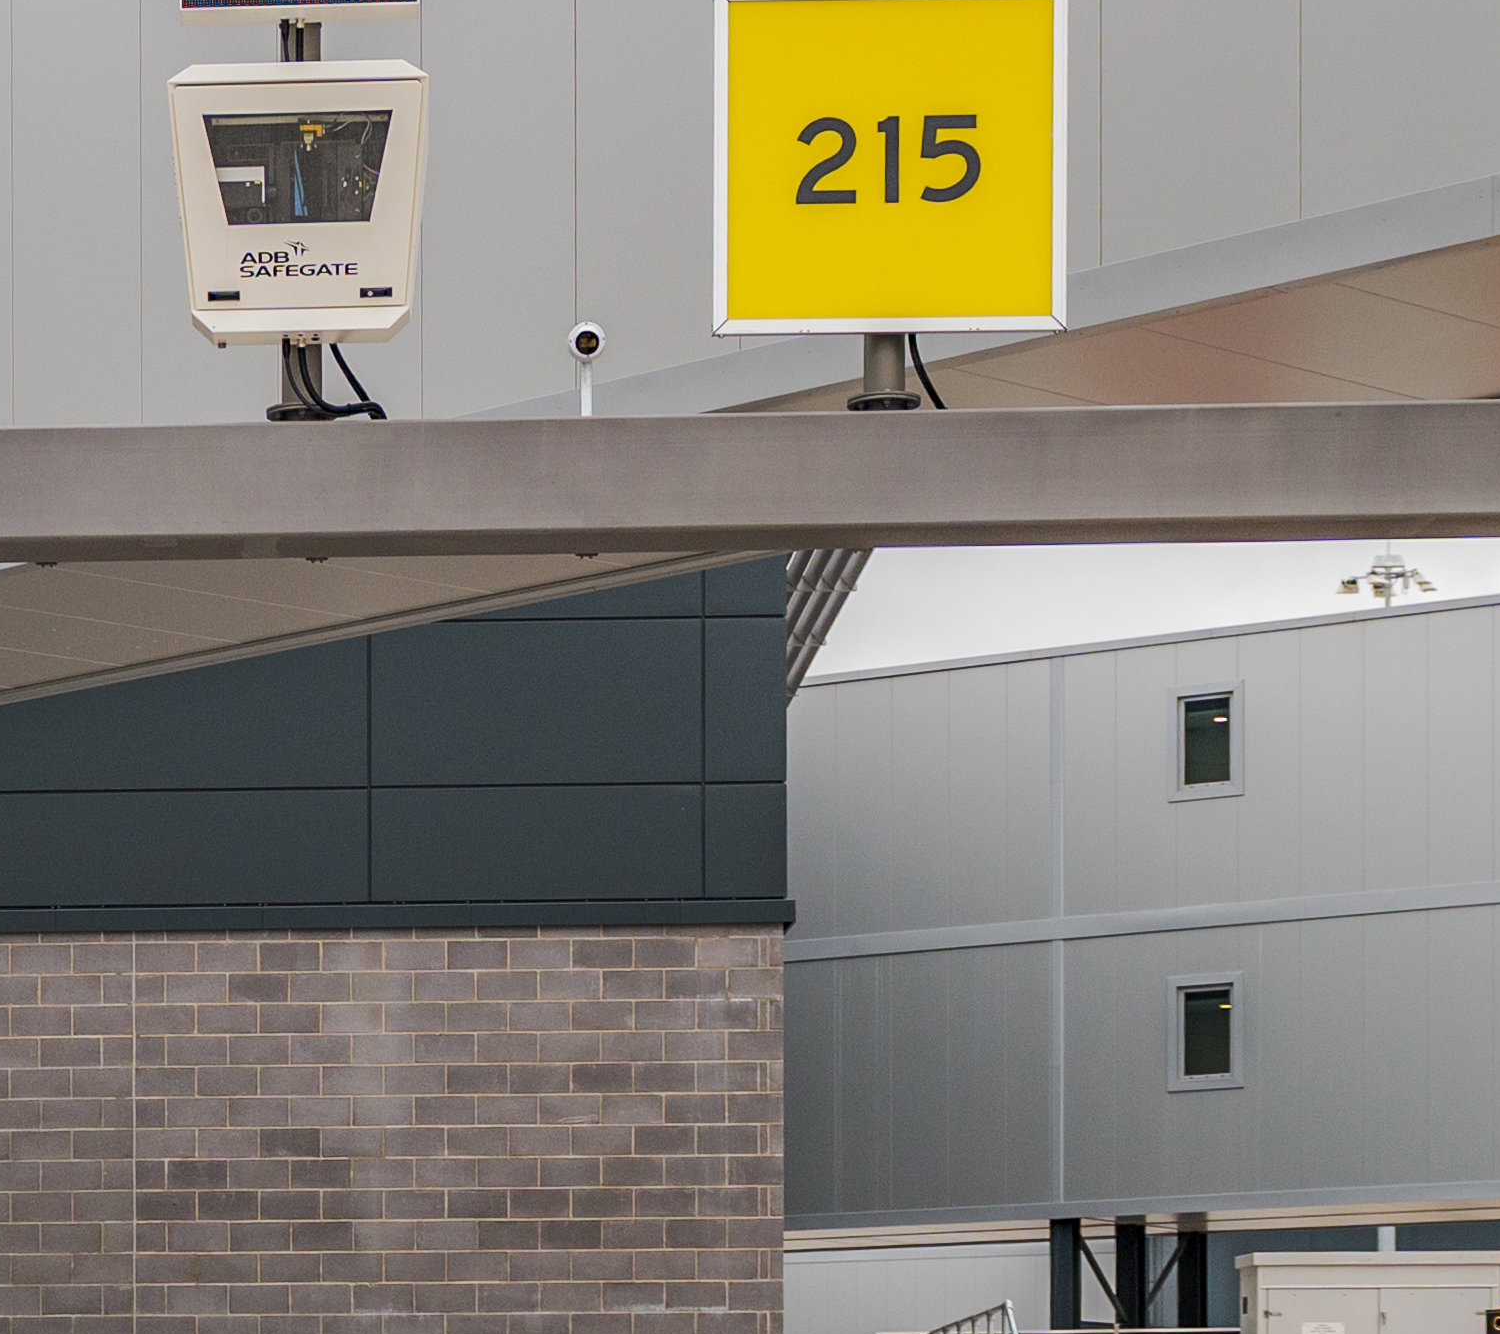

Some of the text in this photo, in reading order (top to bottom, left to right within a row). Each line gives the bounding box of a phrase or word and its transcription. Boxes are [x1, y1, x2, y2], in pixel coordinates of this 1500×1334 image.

[795, 114, 981, 205] 215
[240, 251, 290, 265] ADB
[239, 262, 359, 278] SAFEGATE
